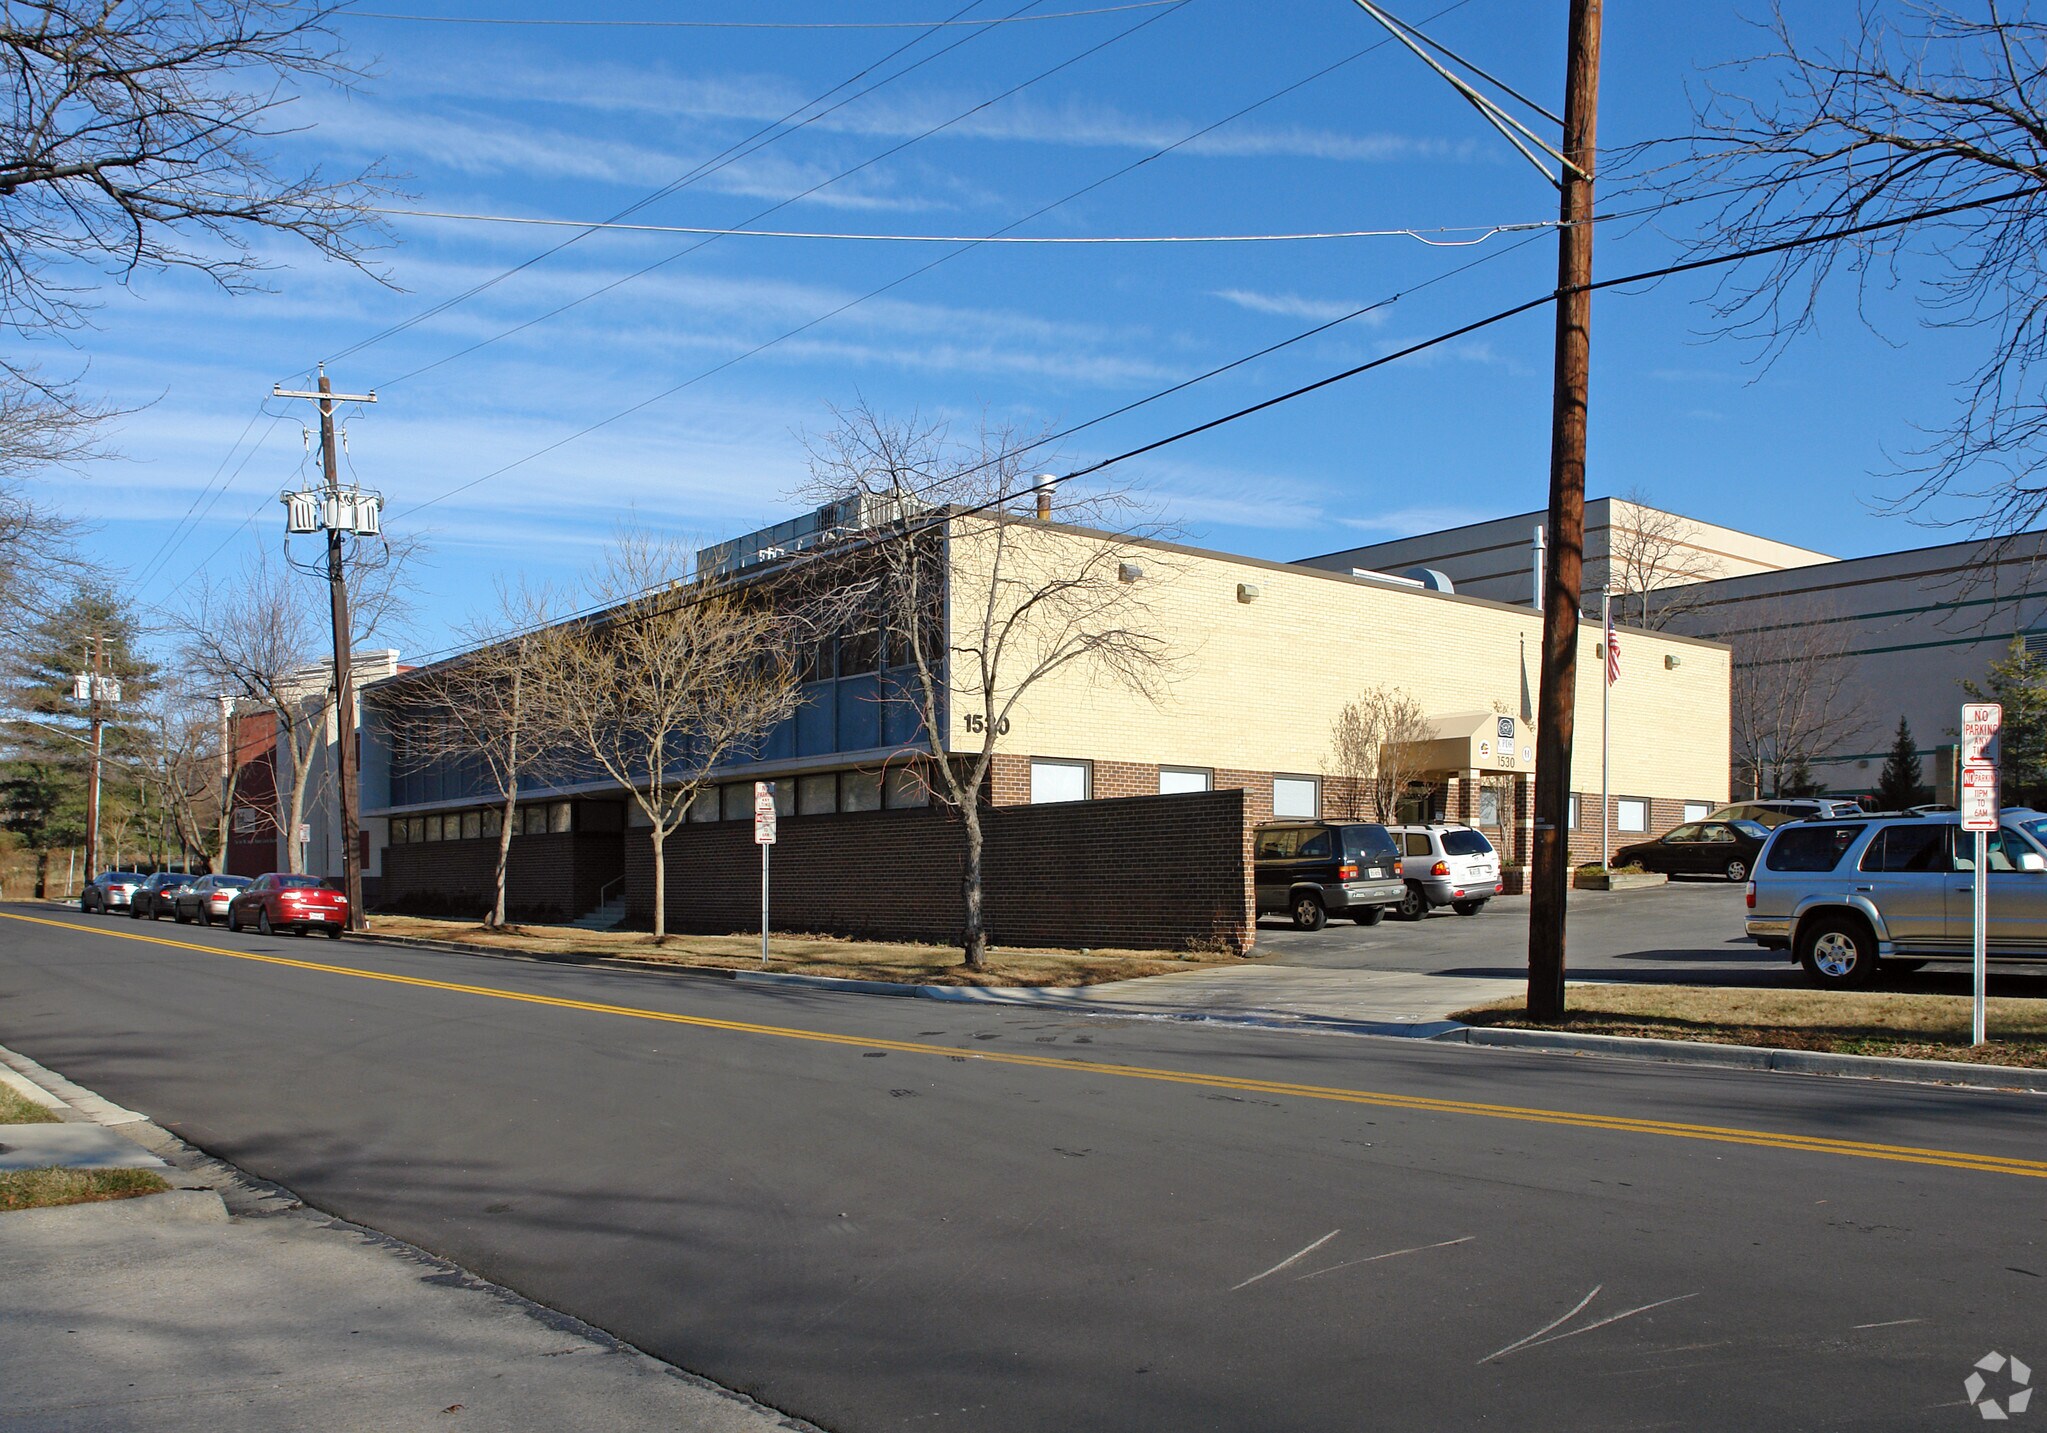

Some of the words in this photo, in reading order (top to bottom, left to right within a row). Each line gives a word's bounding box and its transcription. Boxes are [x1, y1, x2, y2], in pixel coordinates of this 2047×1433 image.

[1974, 710, 1989, 722] NO
[963, 713, 1010, 736] 150
[1965, 724, 1998, 736] PARKING
[1974, 737, 1989, 745] ANY
[1973, 745, 1990, 755] TIME
[1497, 755, 1515, 768] 1530
[1964, 772, 1974, 785] NO
[1974, 789, 1988, 798] 11PM
[1977, 799, 1985, 807] TO
[1974, 809, 1988, 817] 6AM
